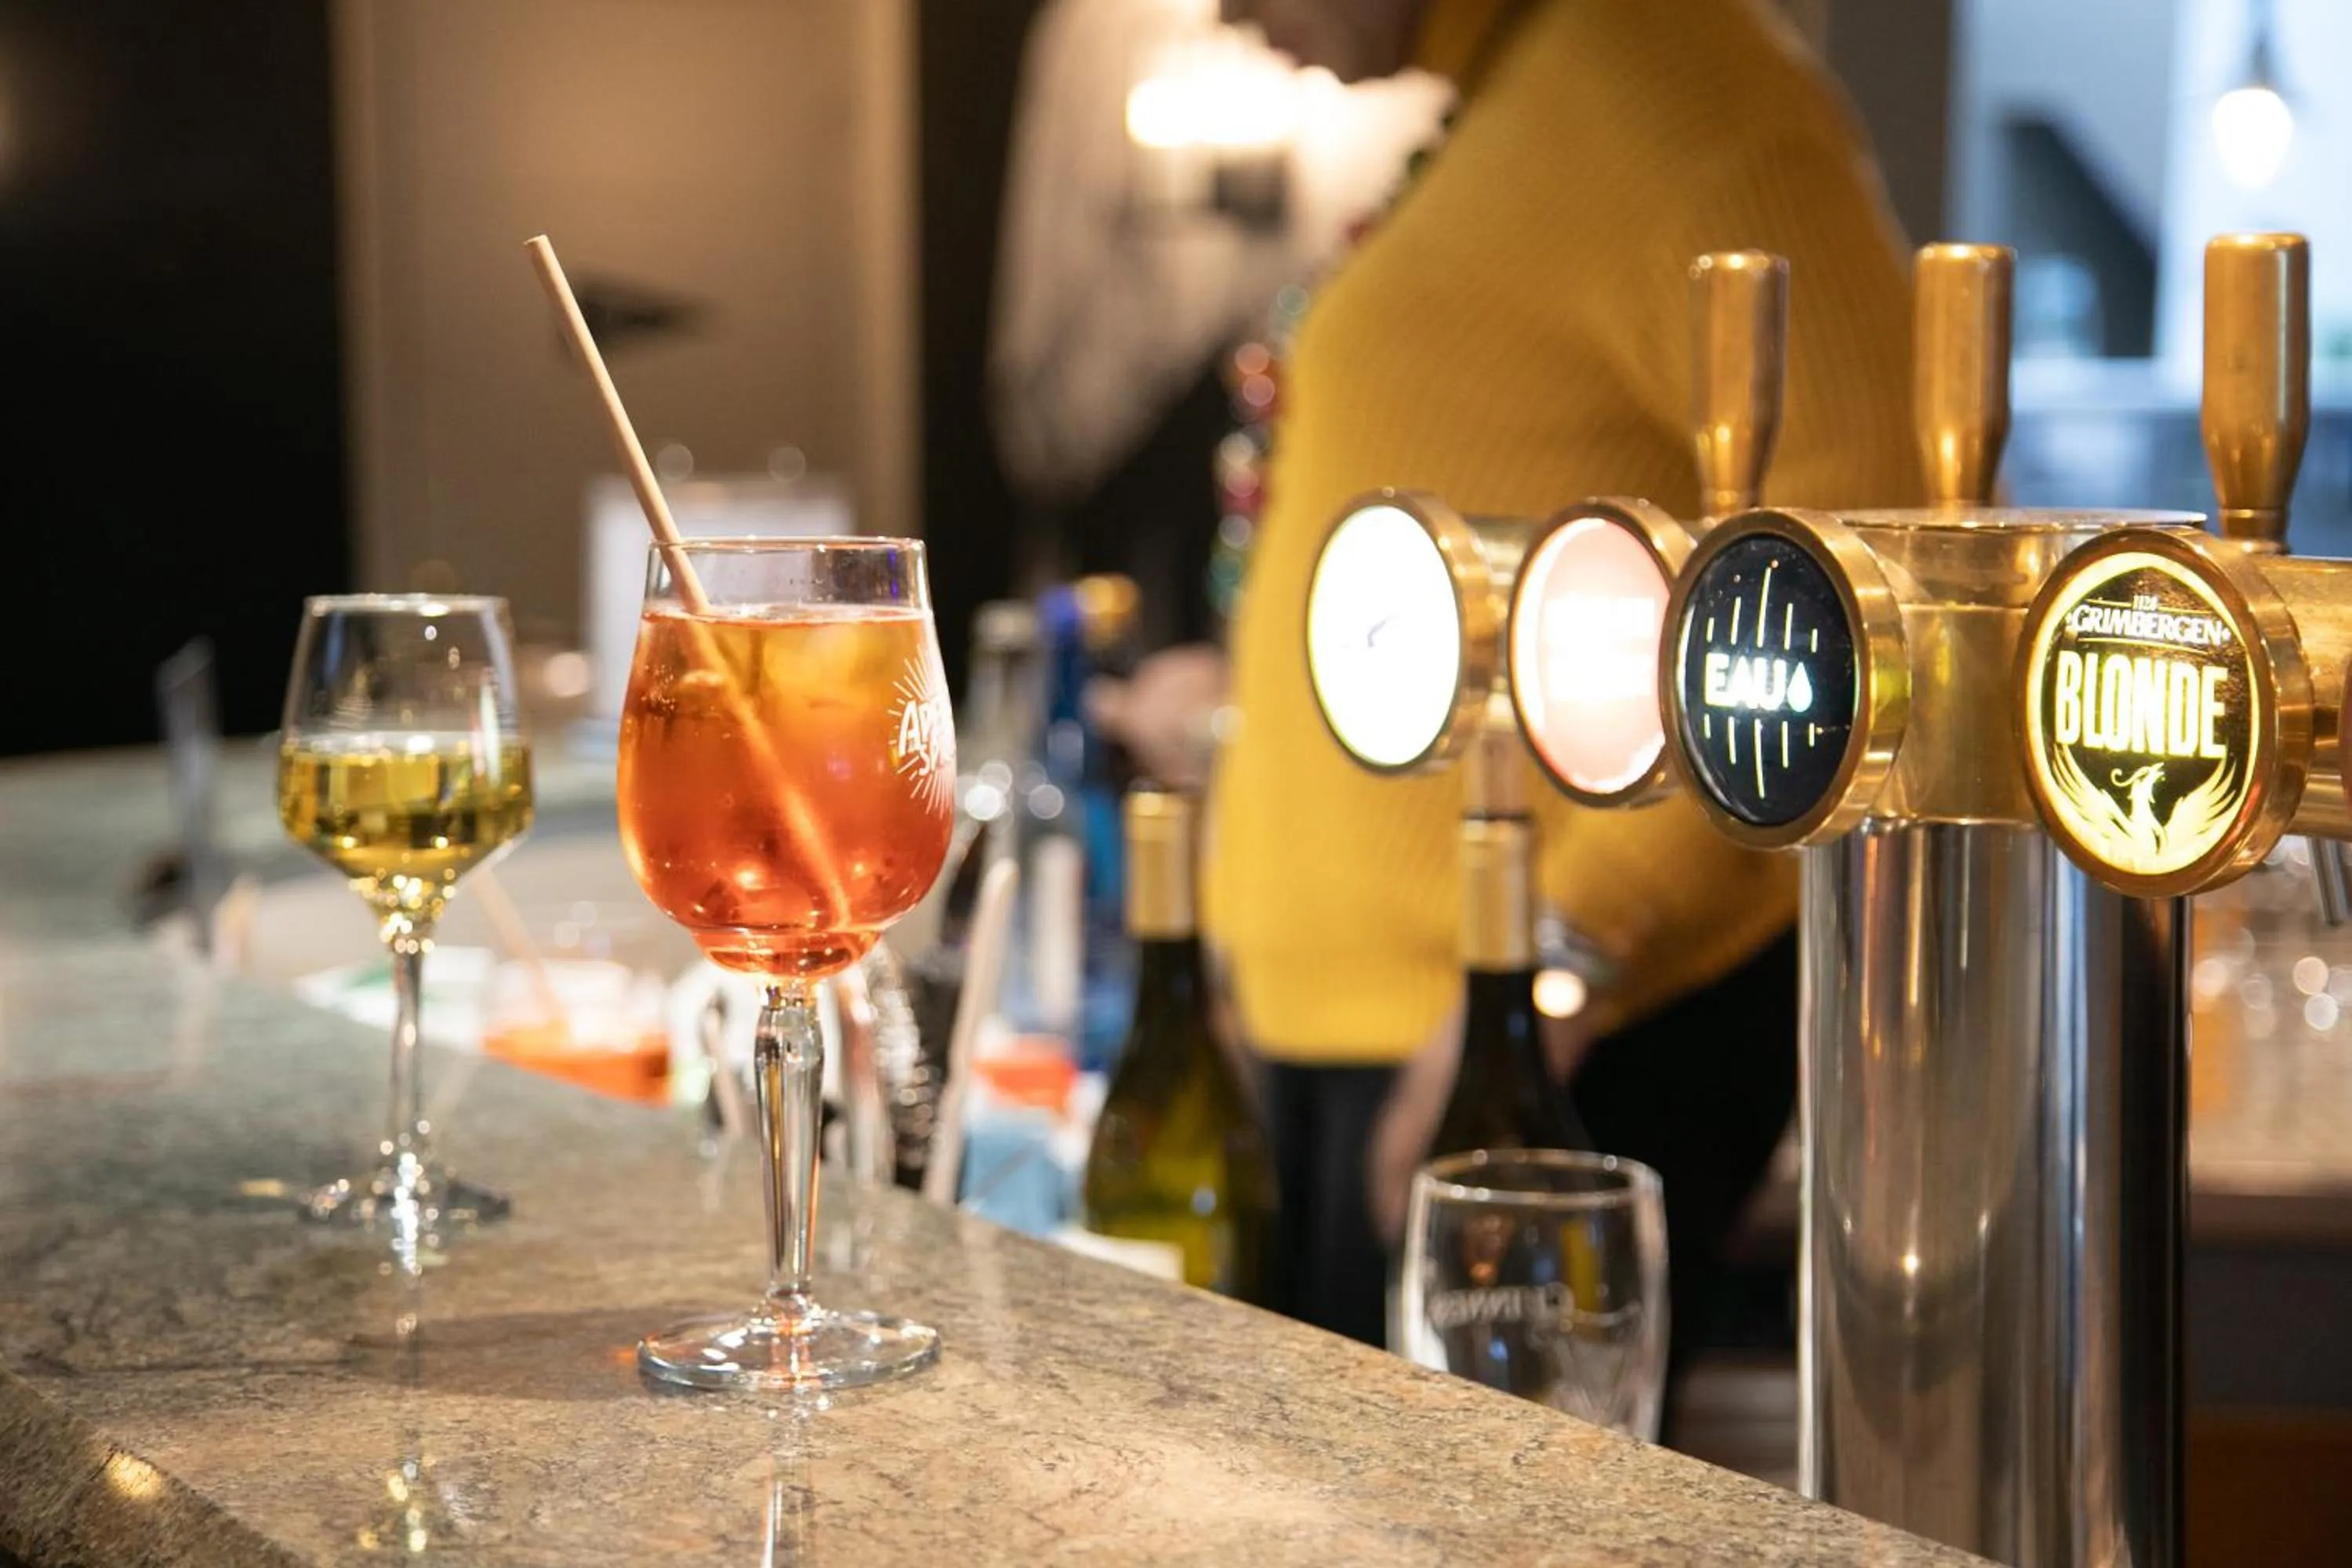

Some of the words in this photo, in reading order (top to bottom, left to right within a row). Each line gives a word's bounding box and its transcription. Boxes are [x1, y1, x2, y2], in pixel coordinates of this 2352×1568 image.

[2071, 604, 2223, 646] GRIMBERGEN
[1704, 652, 1787, 711] EAU
[2055, 650, 2228, 759] BLONDE
